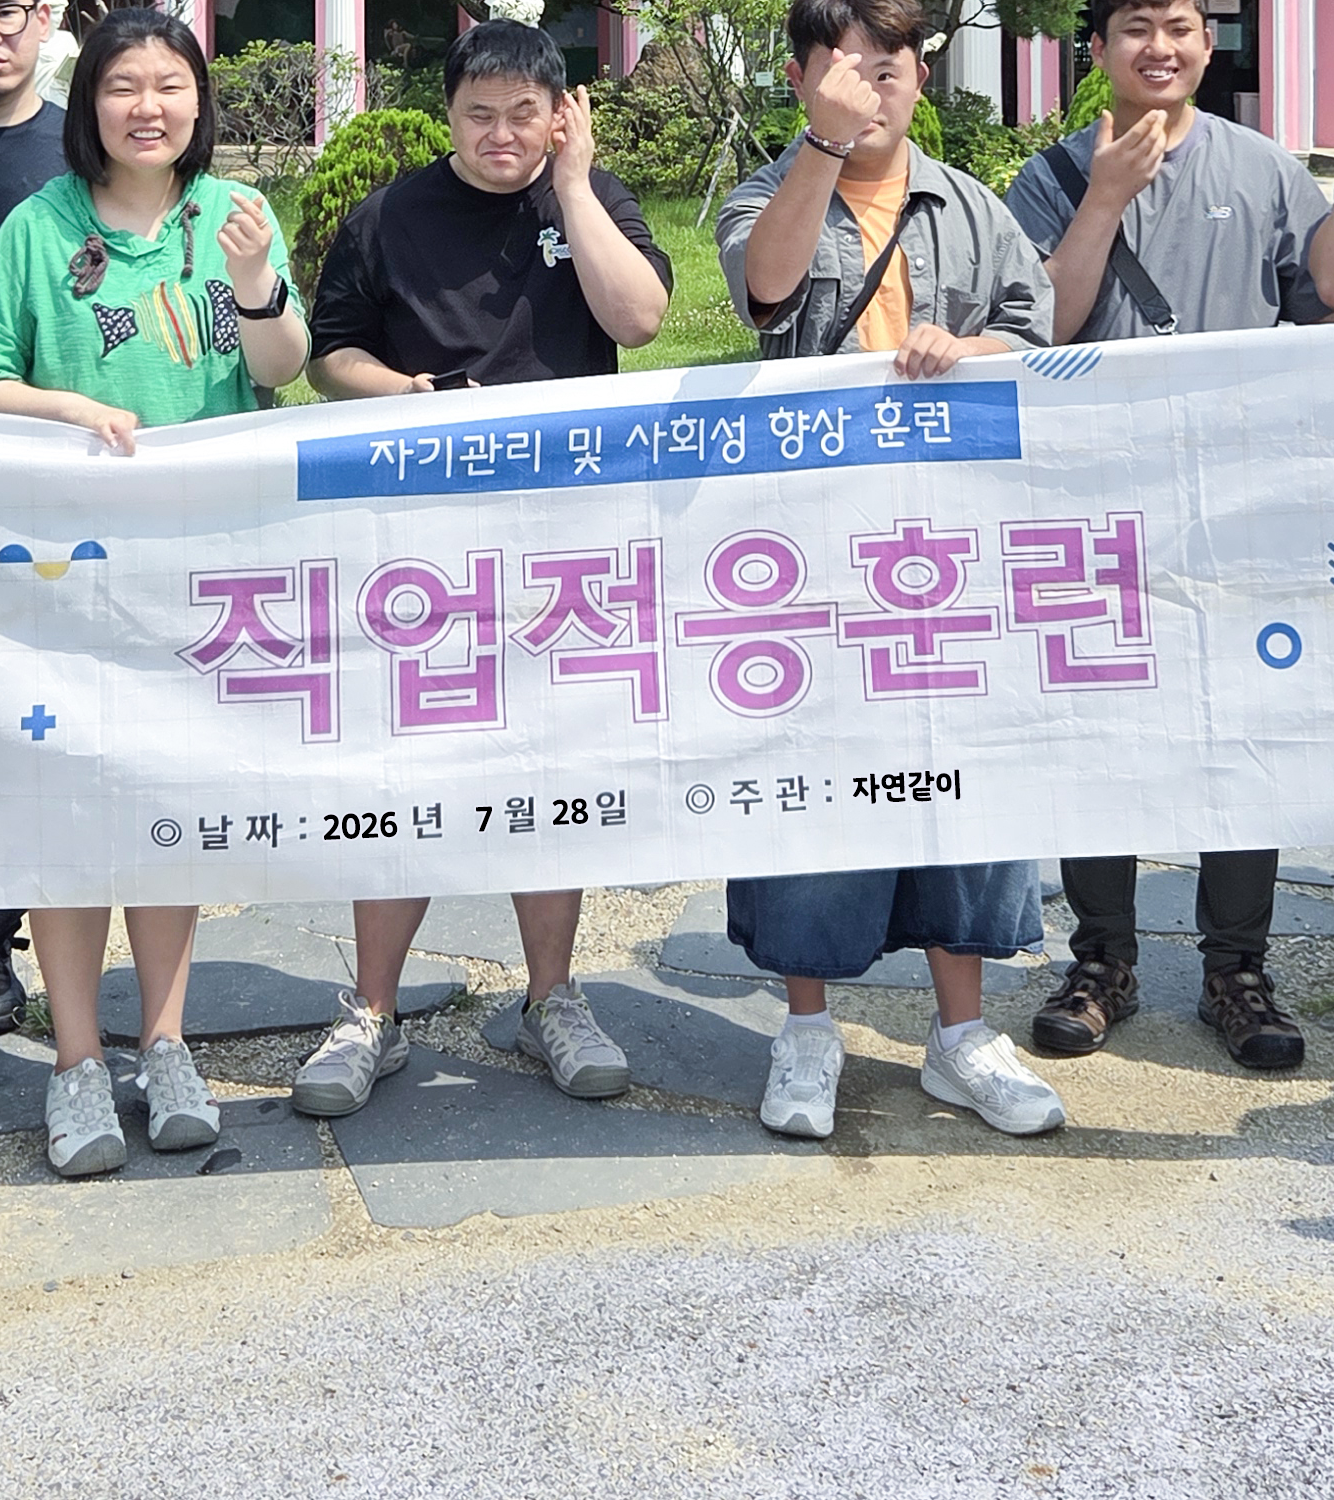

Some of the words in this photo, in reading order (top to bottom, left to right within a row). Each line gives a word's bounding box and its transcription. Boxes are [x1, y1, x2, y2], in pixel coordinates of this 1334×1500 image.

[369, 427, 543, 481] 자기관리
[568, 425, 602, 476] 및
[624, 413, 747, 465] 사회성
[767, 405, 853, 461] 향상
[869, 395, 953, 450] 훈련
[175, 511, 1158, 744] 직업적응훈련
[851, 768, 962, 805] 자연같이
[322, 810, 399, 842] 2026
